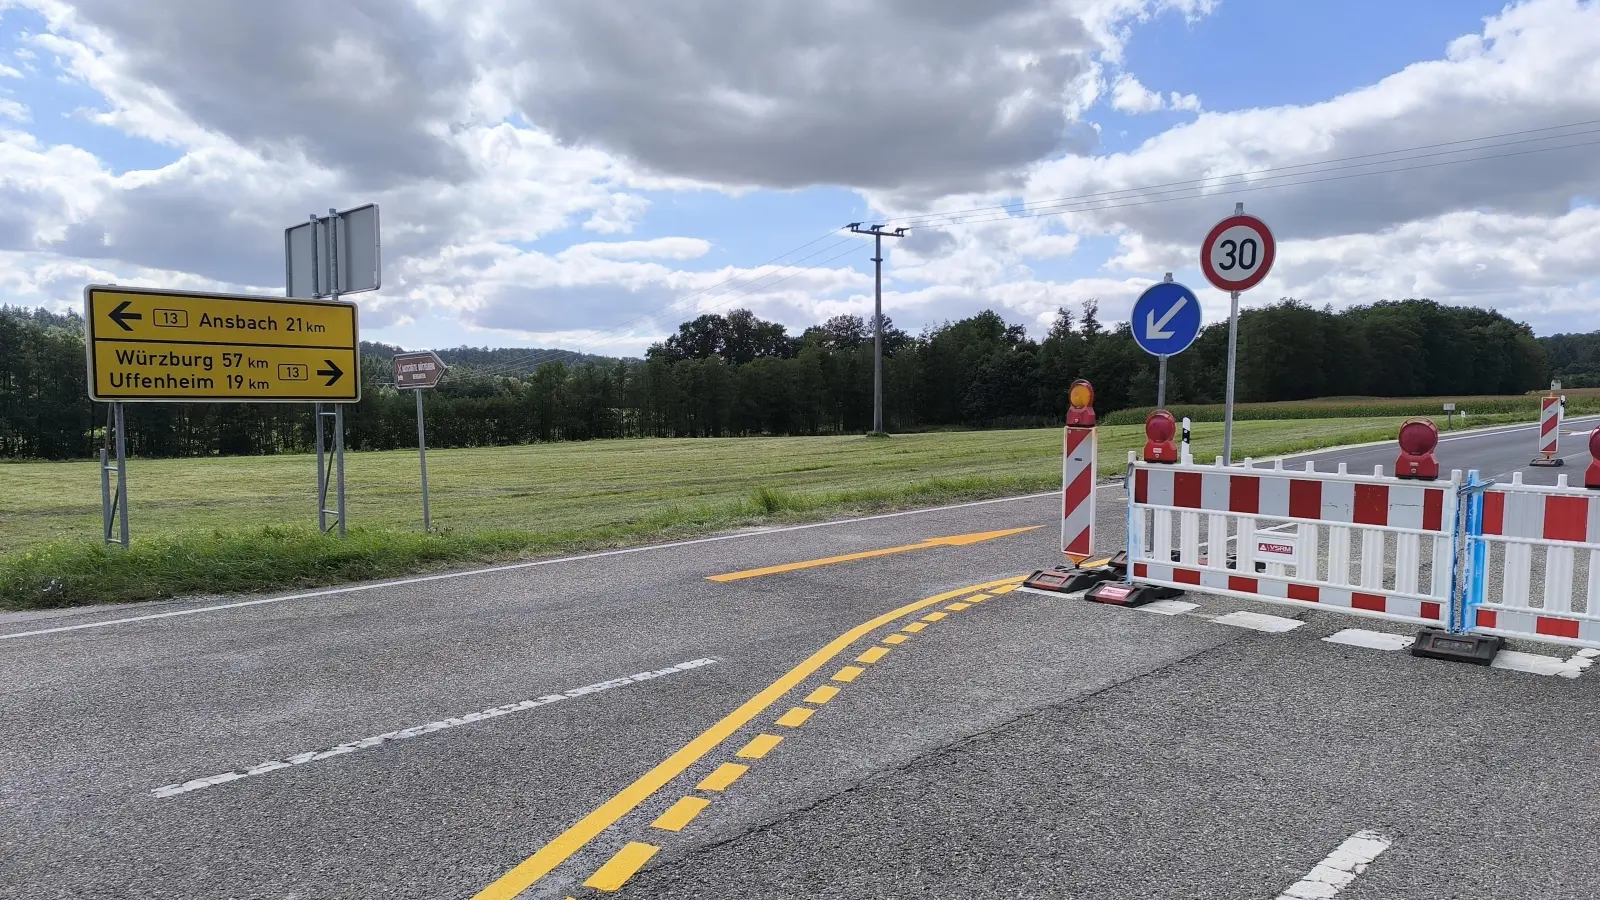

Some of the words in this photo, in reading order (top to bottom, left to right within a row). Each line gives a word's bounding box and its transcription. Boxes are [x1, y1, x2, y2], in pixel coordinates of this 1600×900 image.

[1218, 238, 1257, 271] 30
[163, 313, 178, 325] 13
[199, 312, 278, 331] Ansbach
[286, 317, 302, 332] 21
[306, 321, 326, 333] km
[115, 349, 213, 371] Würzburg
[222, 353, 243, 369] 57
[248, 357, 269, 369] km
[109, 372, 214, 389] Uffenheim
[227, 375, 244, 389] 19
[249, 378, 270, 390] km
[286, 366, 300, 378] 13
